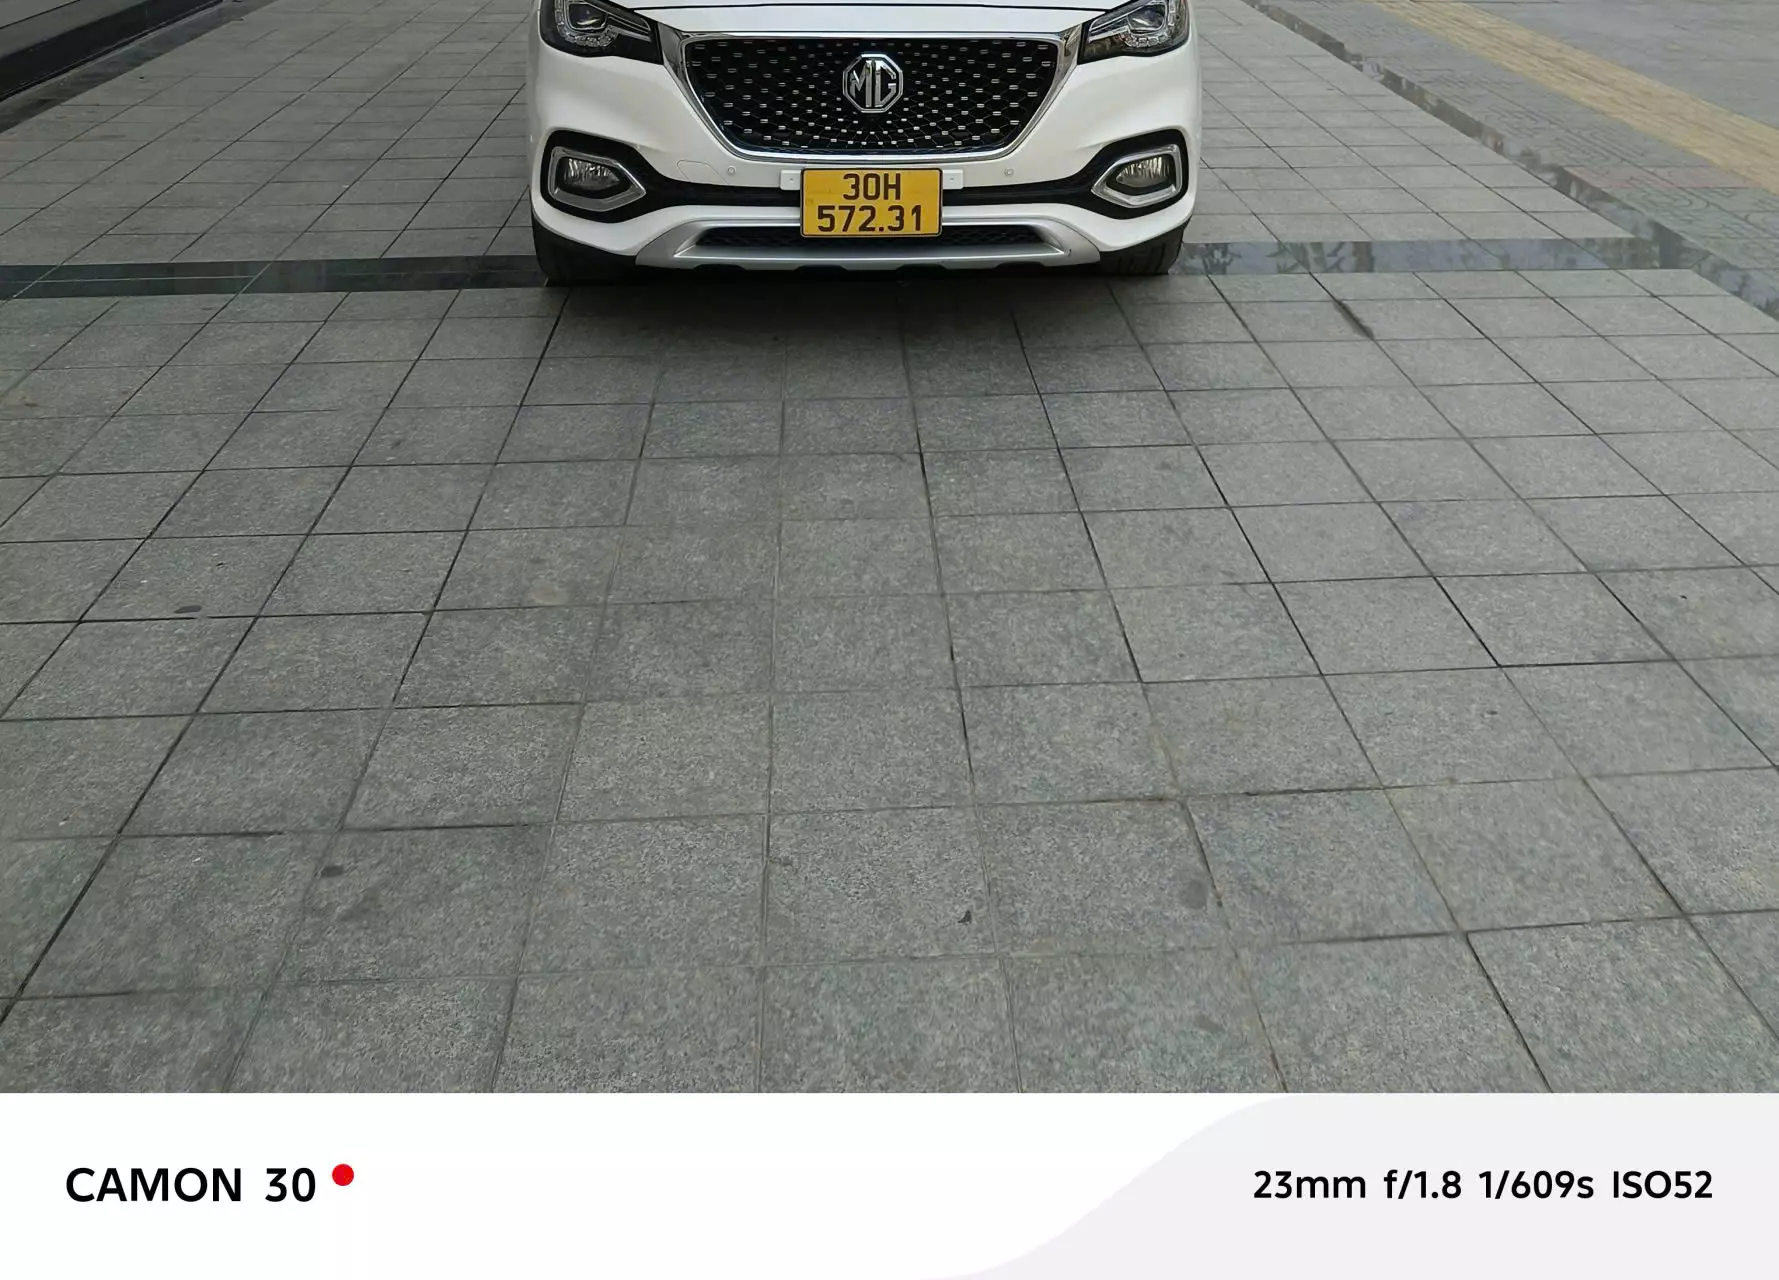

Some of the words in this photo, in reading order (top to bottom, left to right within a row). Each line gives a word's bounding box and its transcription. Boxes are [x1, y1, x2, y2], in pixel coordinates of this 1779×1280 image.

[850, 60, 897, 107] MG
[843, 173, 901, 200] 30H
[817, 205, 922, 232] 572.31
